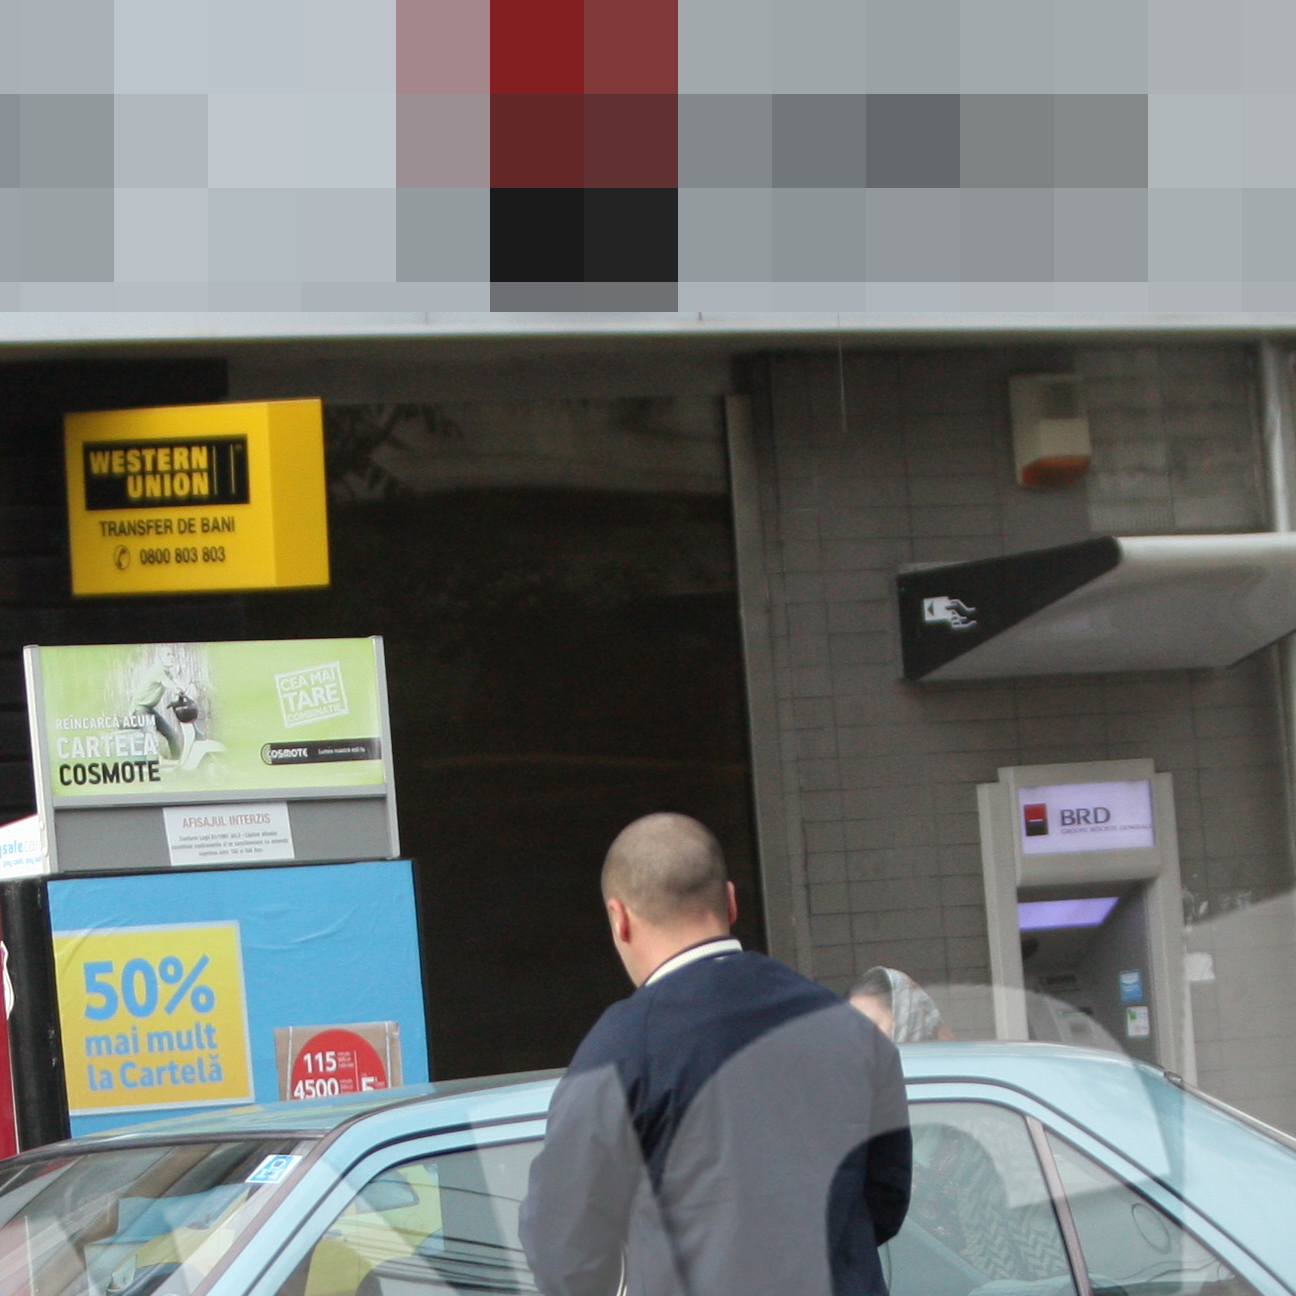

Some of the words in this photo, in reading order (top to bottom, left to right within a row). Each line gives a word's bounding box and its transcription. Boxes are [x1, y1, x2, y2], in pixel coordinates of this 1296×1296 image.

[89, 445, 208, 474] WESTERN
[127, 472, 210, 498] UNION
[99, 518, 173, 537] TRANSFER
[177, 517, 196, 534] DE
[201, 516, 235, 533] BANI
[140, 548, 171, 565] 0800
[175, 547, 198, 563] 803
[202, 546, 225, 562] 803
[280, 675, 309, 691] CEA
[310, 668, 336, 685] MAI
[282, 682, 341, 712] TARE
[123, 714, 156, 728] ACUM
[57, 733, 158, 759] CARTELA
[59, 760, 161, 786] COSMOTE
[229, 812, 271, 826] INTERZIS
[1060, 807, 1111, 826] BRD
[83, 953, 216, 1021] 50%
[85, 1025, 140, 1057] mai
[146, 1021, 218, 1053] mult
[87, 1063, 114, 1091] la
[119, 1053, 223, 1089] Cartelă
[303, 1050, 338, 1073] 115
[293, 1077, 340, 1100] 4500
